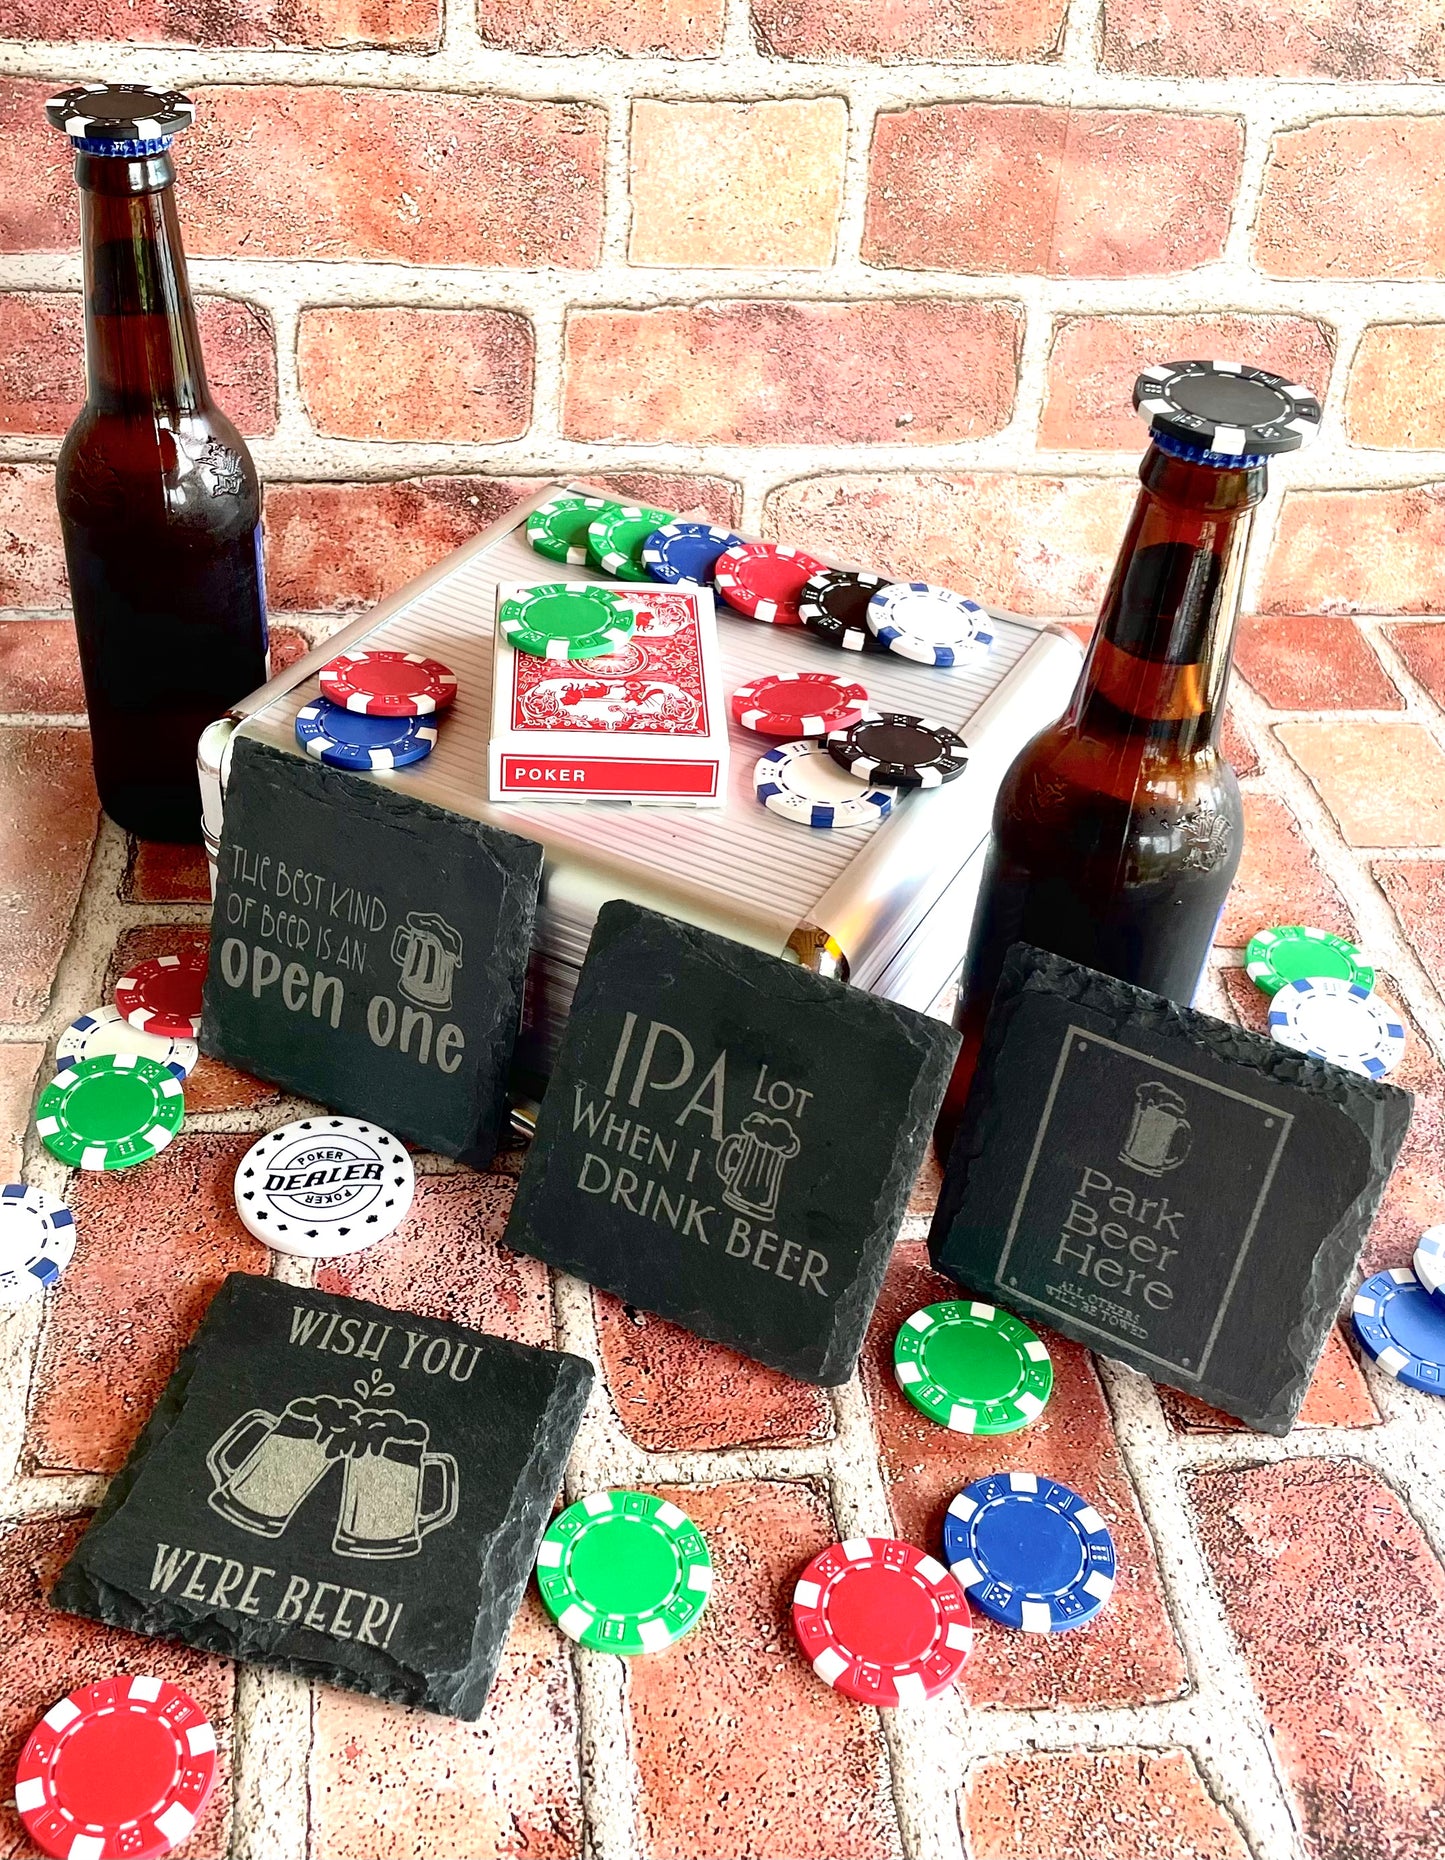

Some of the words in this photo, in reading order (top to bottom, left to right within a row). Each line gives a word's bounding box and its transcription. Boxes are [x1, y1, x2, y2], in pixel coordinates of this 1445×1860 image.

[515, 767, 586, 782] POKER
[227, 893, 256, 928] OF
[316, 926, 331, 960] IS
[336, 936, 366, 974] AN
[329, 882, 387, 931] KIND
[604, 1011, 727, 1142] IPA
[752, 1064, 814, 1118] LOT
[298, 1151, 343, 1165] POKER
[572, 1080, 677, 1171] WHEN
[686, 1149, 701, 1182] I
[263, 1163, 384, 1191] DEALER
[305, 1189, 352, 1204] POKER
[1075, 1166, 1185, 1241] Park
[577, 1152, 716, 1245] DRINK
[724, 1217, 829, 1298] BEER
[1062, 1200, 1179, 1272] Beer
[1052, 1232, 1174, 1310] Here
[288, 1306, 393, 1363] WISH
[398, 1331, 483, 1383] YOU
[1087, 1294, 1141, 1324] OTHERS
[1101, 1309, 1149, 1340] TOWED
[149, 1543, 276, 1615] WERE
[277, 1575, 404, 1650] BEER!
